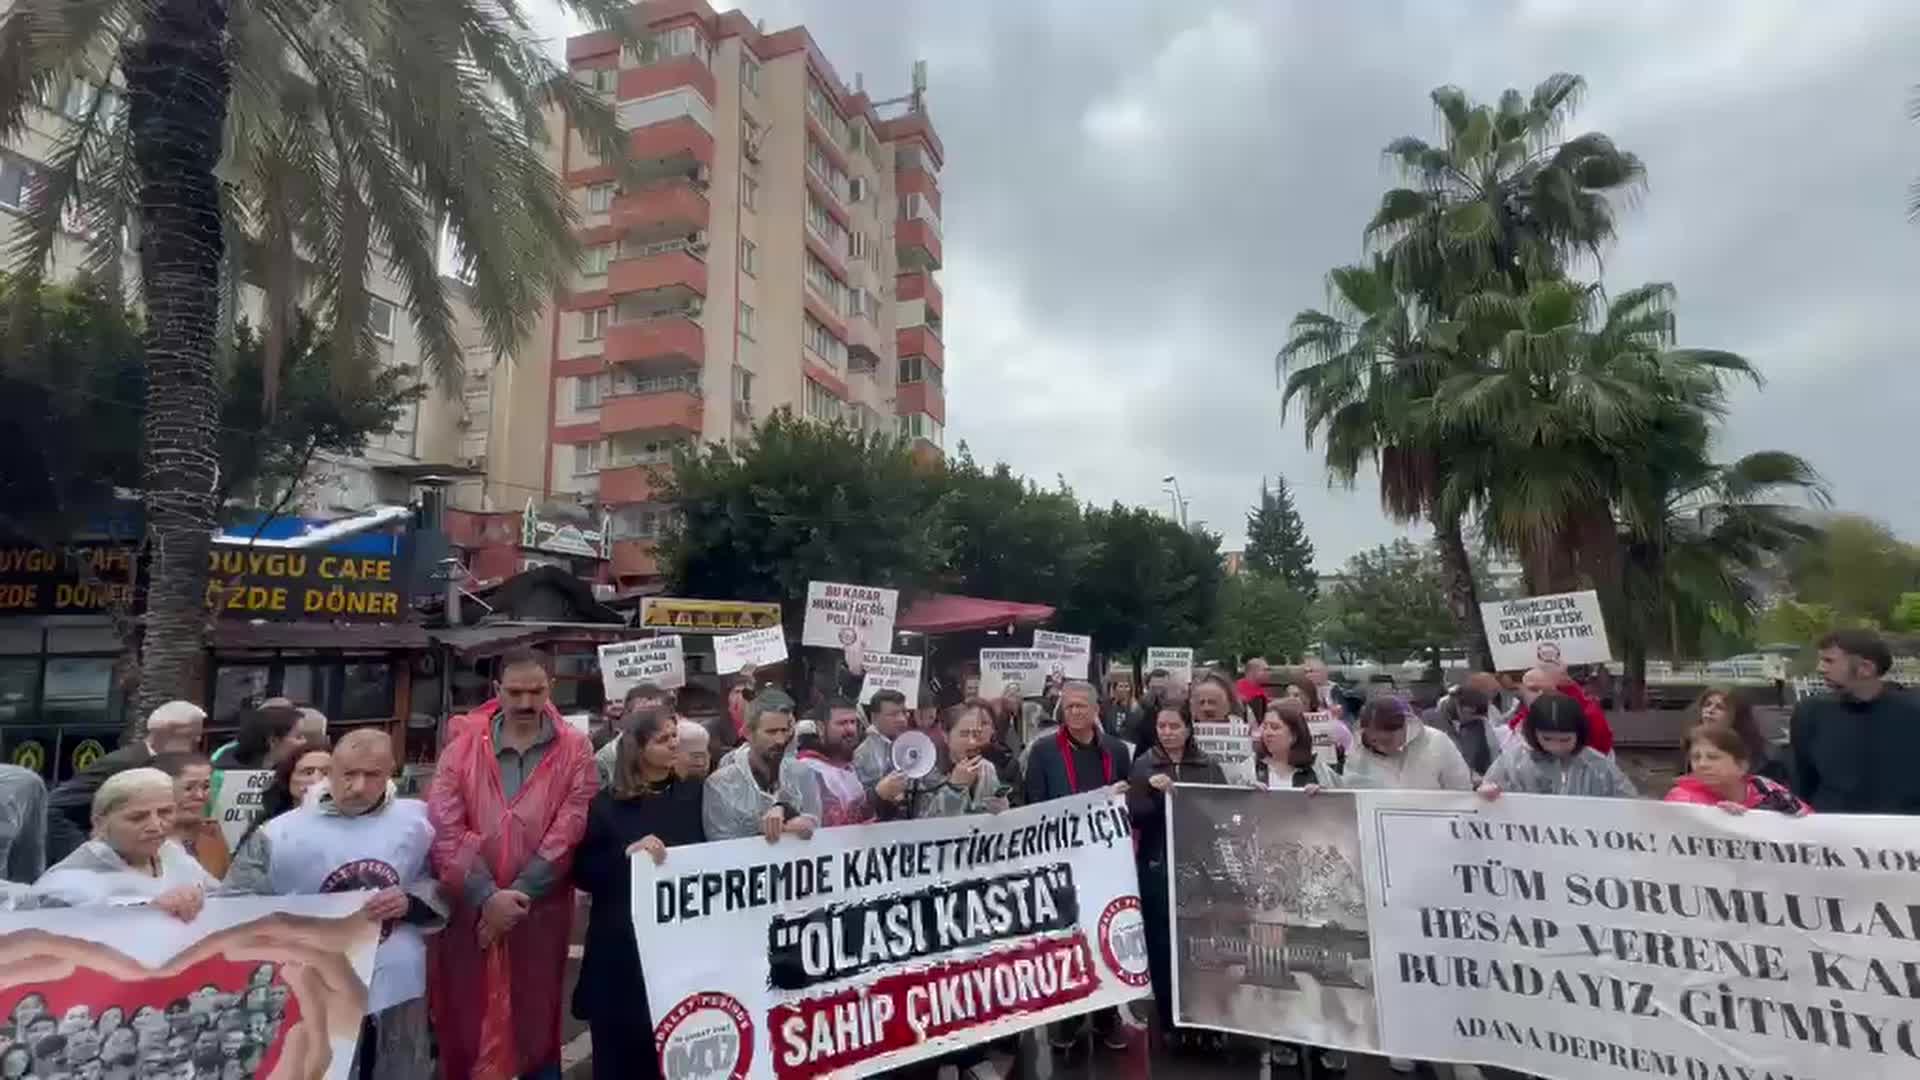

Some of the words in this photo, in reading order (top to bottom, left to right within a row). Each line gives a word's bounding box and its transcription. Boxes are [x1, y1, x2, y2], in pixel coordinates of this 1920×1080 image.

[319, 556, 391, 581] CAFE
[304, 584, 399, 614] DÖNER
[1499, 631, 1532, 645] OLASI
[656, 855, 833, 924] DEPREMDE
[843, 809, 1084, 890] KAYBETTİKLERİMİZ
[1450, 821, 1580, 846] UNUTMAK
[1585, 828, 1657, 852] YOK!
[1668, 834, 1846, 867] AFFETMEK
[1453, 859, 1546, 901] TÜM
[777, 898, 928, 977] "OLASI
[935, 871, 1067, 947] KASTA"
[1420, 907, 1559, 949] HESAP
[1577, 923, 1789, 980] VERENE
[782, 985, 895, 1068] SAHİP
[906, 944, 1089, 1046] ÇIKIYORUZ!
[1399, 952, 1660, 1018] BURADAYIZ
[1454, 1016, 1544, 1051] ADANA
[1548, 1031, 1678, 1076] DEPREM
